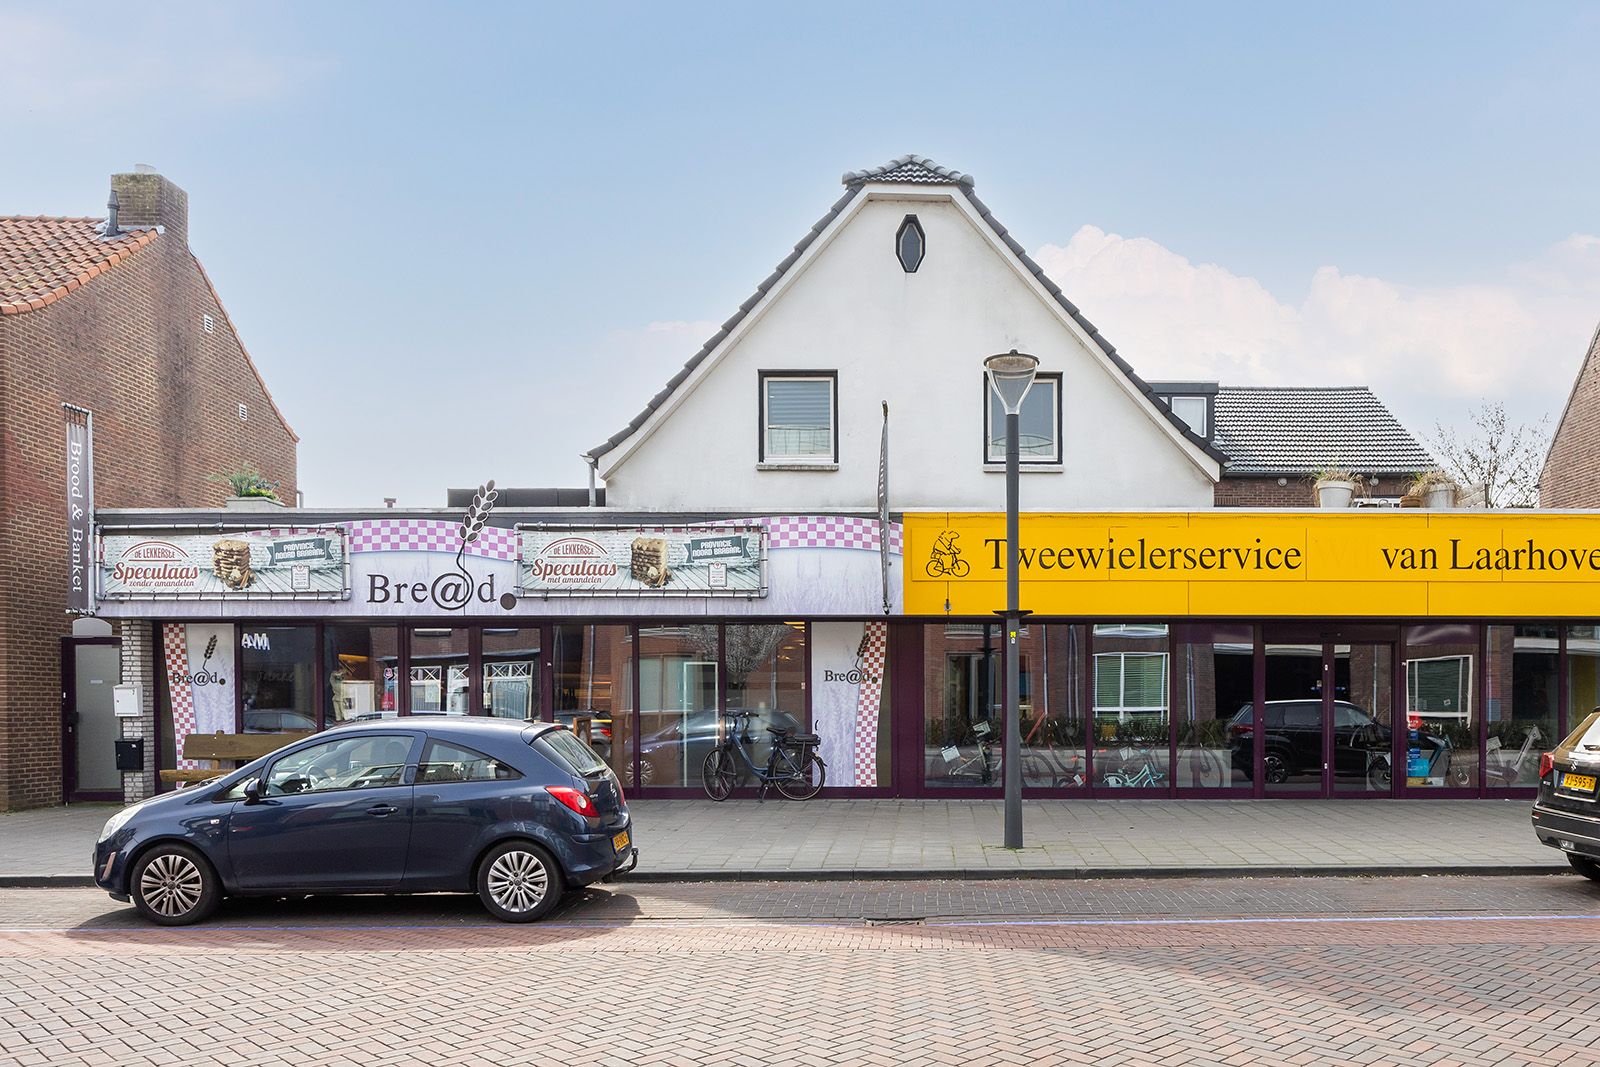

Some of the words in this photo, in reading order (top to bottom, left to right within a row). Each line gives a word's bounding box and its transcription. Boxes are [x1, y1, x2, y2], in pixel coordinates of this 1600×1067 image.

[70, 441, 83, 498] Brood
[71, 503, 84, 521] &
[72, 528, 84, 593] Banket
[984, 538, 1303, 570] Tweewielerservice
[1381, 548, 1439, 570] van
[1449, 538, 1600, 571] Laarhove
[112, 561, 199, 584] Speculaas
[531, 558, 617, 581] Speculaas
[562, 576, 602, 584] amandelen
[129, 579, 153, 587] zonder
[154, 579, 195, 587] amandelen
